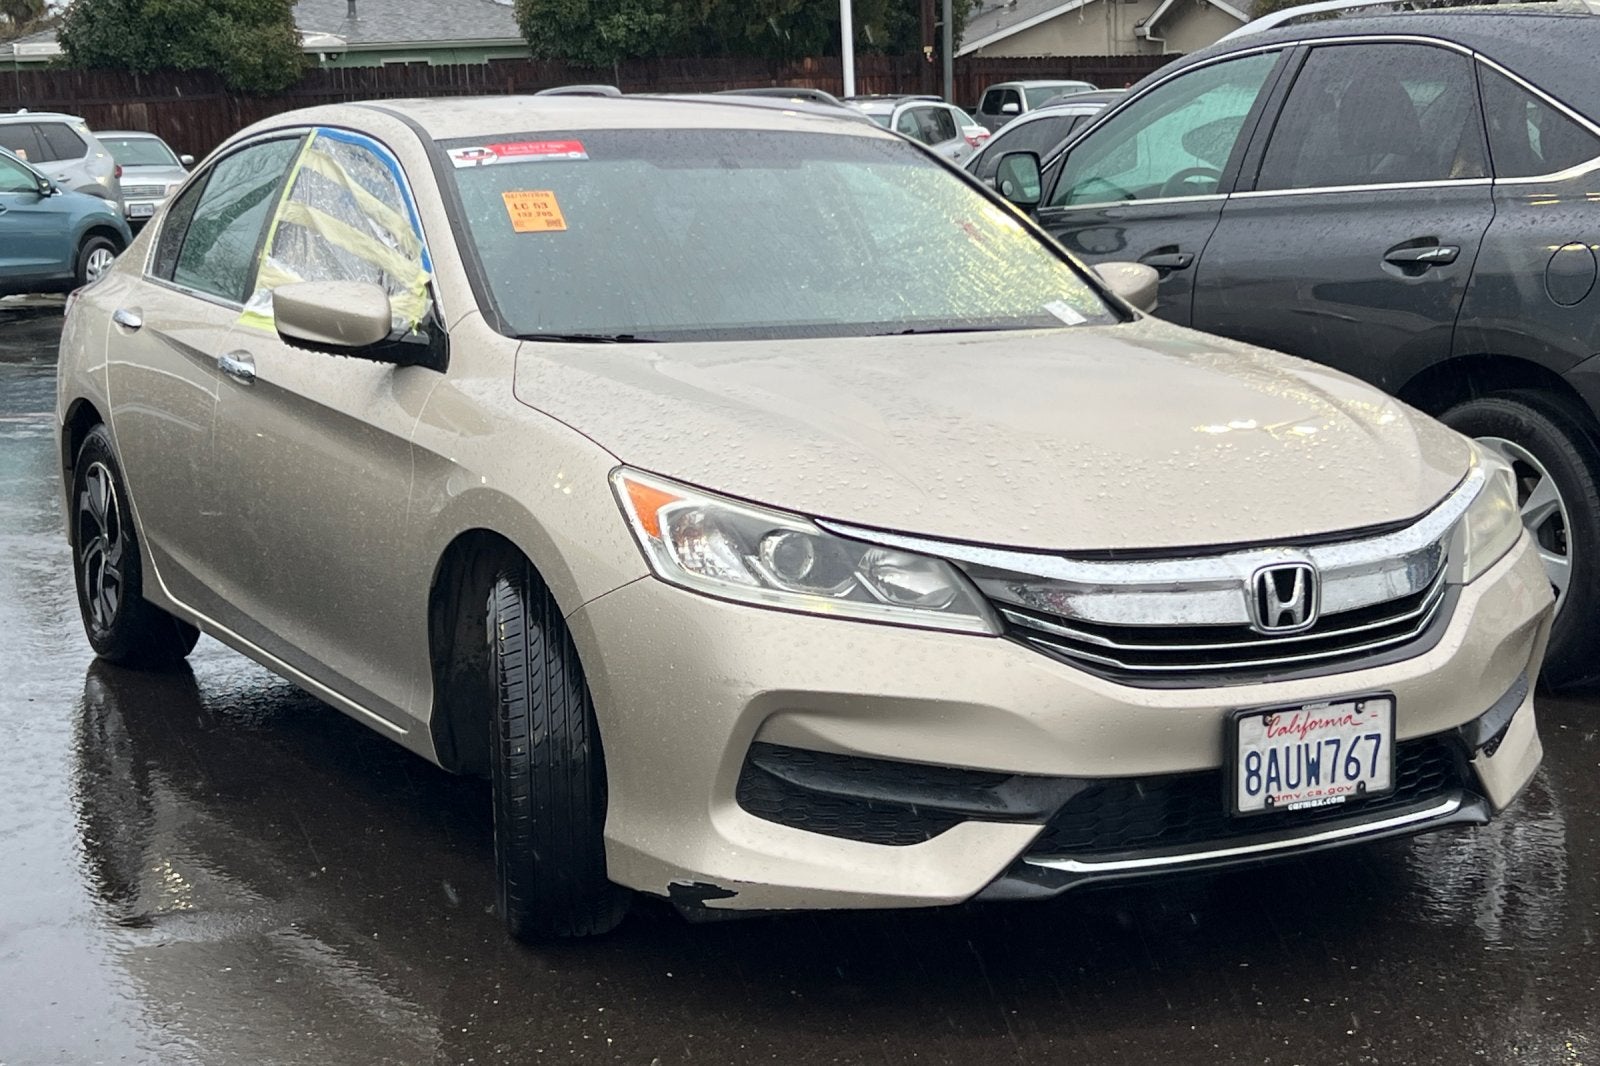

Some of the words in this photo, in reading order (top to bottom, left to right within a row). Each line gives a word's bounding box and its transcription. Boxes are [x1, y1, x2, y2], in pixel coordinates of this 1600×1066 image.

[1266, 711, 1363, 741] California
[1244, 732, 1382, 797] 8AUW767
[1273, 784, 1354, 803] dmv.ca.gov
[1287, 795, 1346, 811] carmax.com
